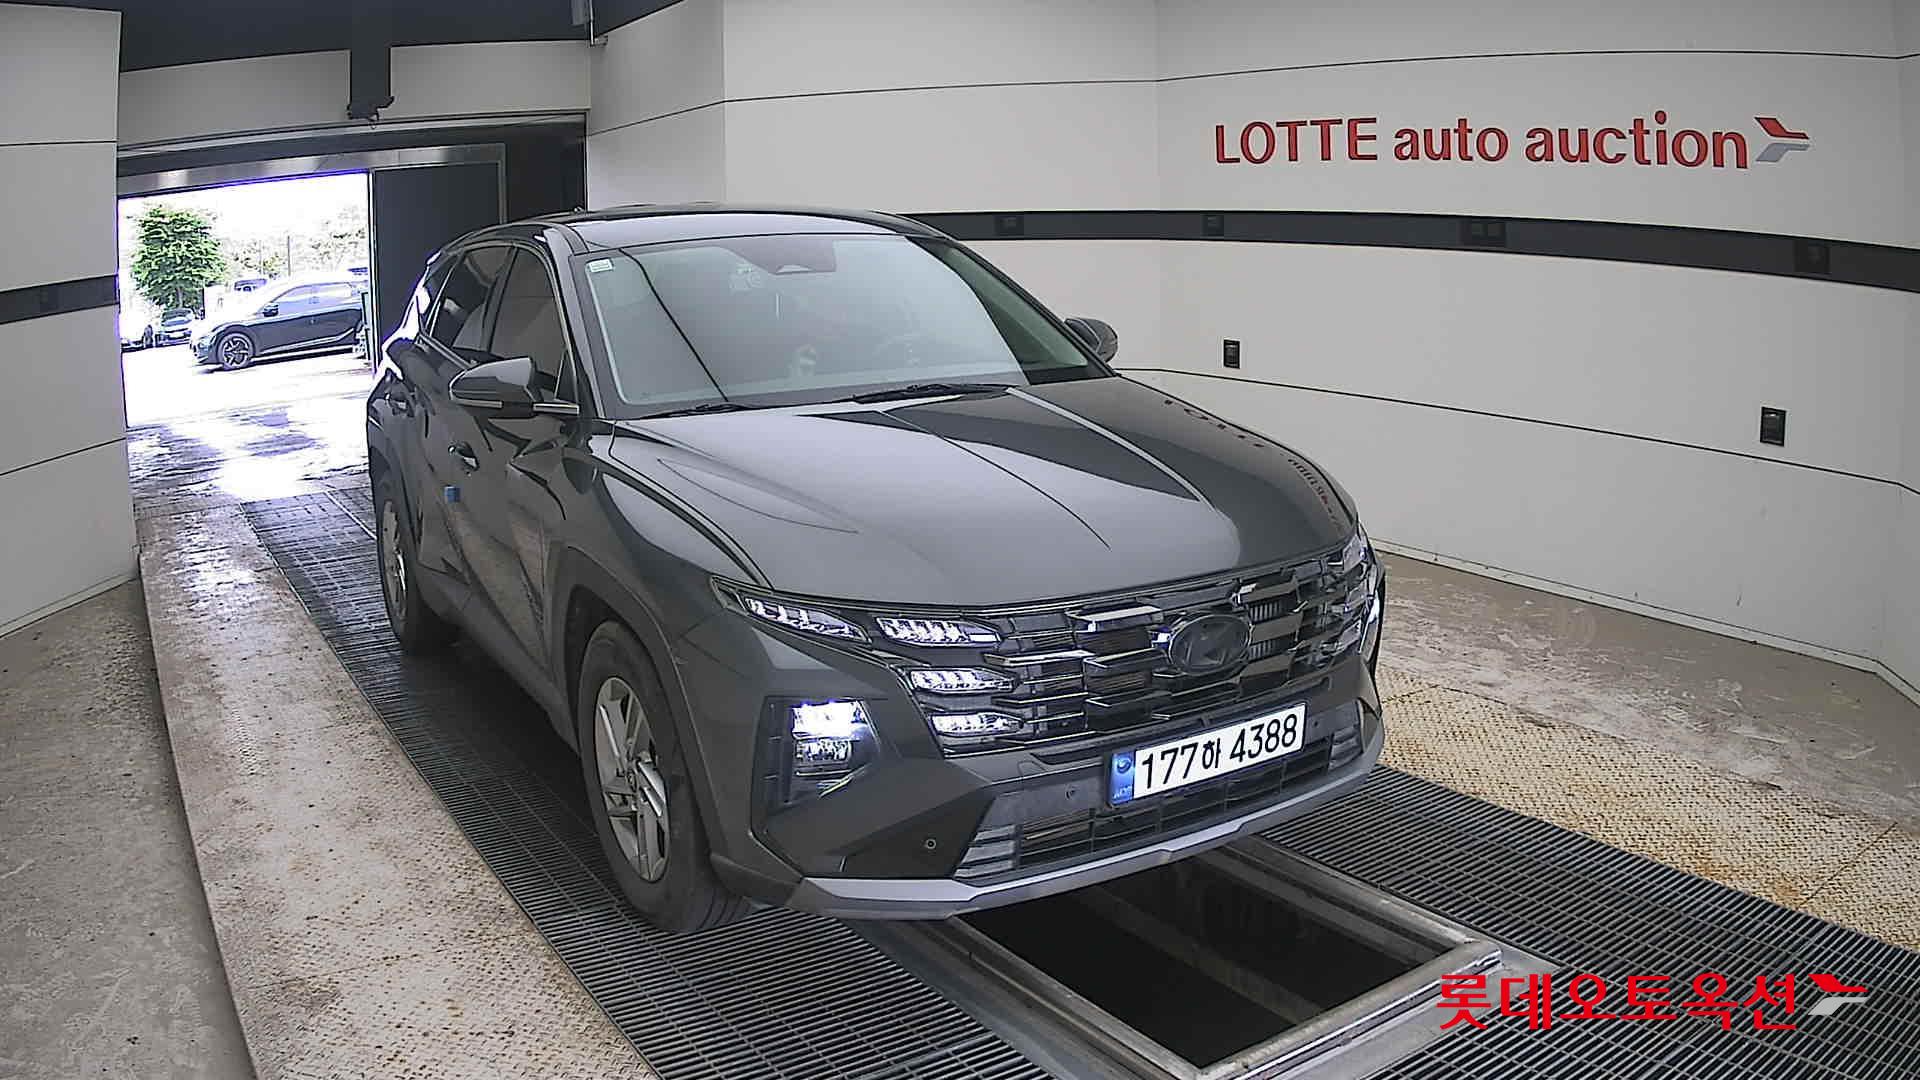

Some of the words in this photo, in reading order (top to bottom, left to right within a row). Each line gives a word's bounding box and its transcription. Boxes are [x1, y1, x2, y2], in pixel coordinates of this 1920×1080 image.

[1215, 117, 1378, 164] LOTTE
[1394, 118, 1509, 162] auto
[1525, 110, 1748, 169] auction
[1141, 737, 1222, 789] 177하
[1229, 713, 1298, 763] 4388
